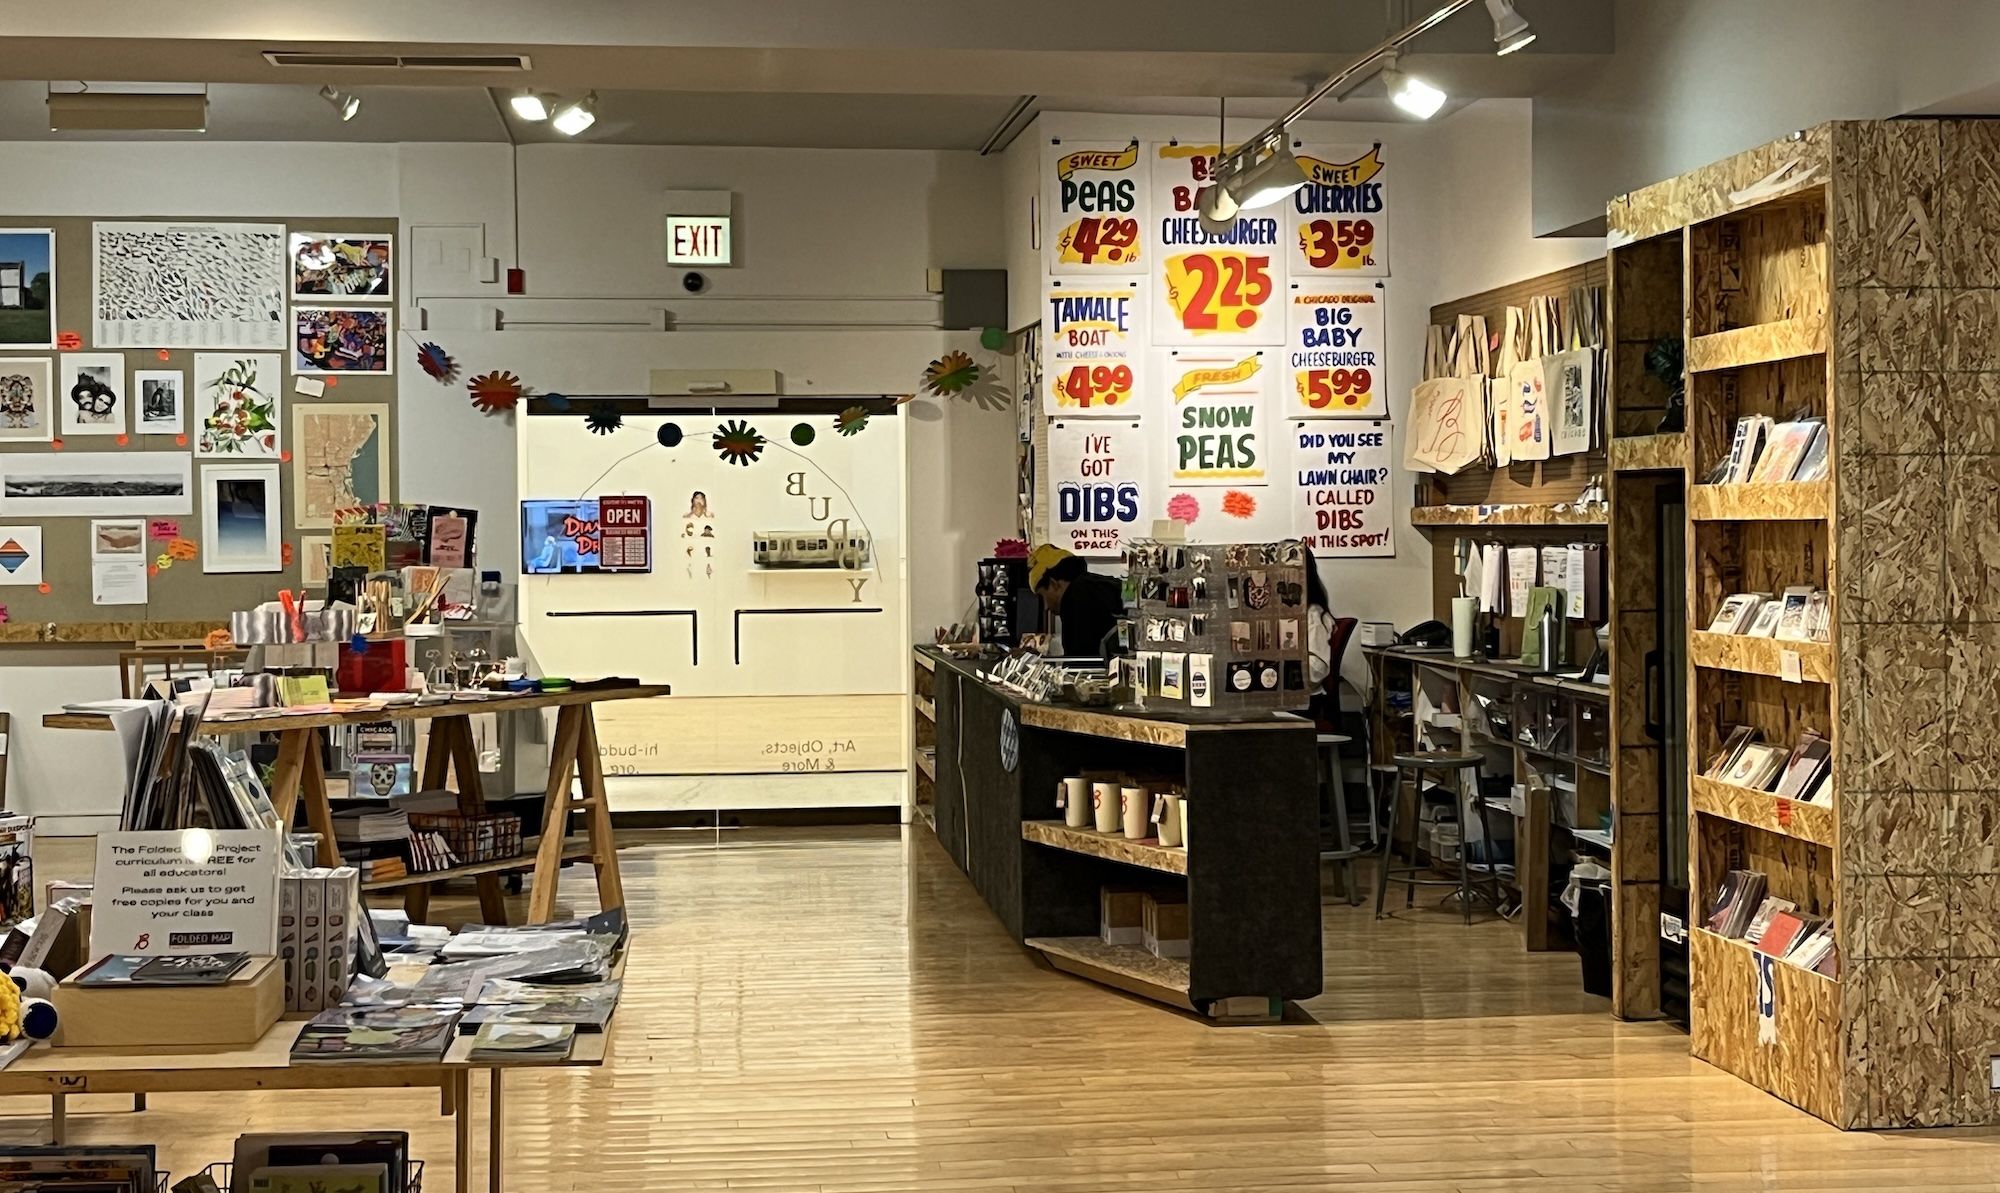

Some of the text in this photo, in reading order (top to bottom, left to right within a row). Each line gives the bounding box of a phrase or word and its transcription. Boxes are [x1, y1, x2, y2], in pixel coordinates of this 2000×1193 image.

[1069, 154, 1121, 168] SWEET
[1312, 164, 1360, 182] SWEET
[1295, 183, 1383, 214] CHERRIES
[675, 225, 722, 257] EXIT
[1050, 297, 1129, 333] TAMALE
[1315, 307, 1352, 326] BIG
[1068, 329, 1111, 347] BOAT
[1302, 327, 1363, 348] BABY
[1292, 352, 1376, 368] CHEESEBURGER
[1193, 371, 1241, 383] FRESH
[1182, 405, 1254, 429] SNOW
[1085, 433, 1111, 454] I'VE
[1300, 433, 1383, 448] DID YOU SEE
[1177, 433, 1256, 470] PEAS
[1328, 452, 1356, 465] MY
[1081, 458, 1115, 476] GOT
[1298, 468, 1388, 486] LAWN CHAIR?
[1057, 481, 1139, 523] DIBS
[1307, 490, 1374, 505] I CALLED
[606, 509, 640, 524] OPEN
[1316, 509, 1364, 530] DIBS
[1071, 528, 1119, 539] ON THIS
[1320, 535, 1349, 548] THIS
[1351, 528, 1389, 547] SPOT!
[1074, 539, 1118, 549] SPACE!
[112, 846, 135, 854] The
[216, 844, 261, 854] Project
[115, 857, 182, 866] curriculum
[237, 856, 256, 864] for
[143, 868, 226, 877] all educators!
[122, 886, 163, 894] Please
[166, 886, 187, 894] ask
[224, 885, 246, 895] get
[112, 896, 255, 907] free copies for you and
[151, 909, 214, 919] your class
[171, 934, 209, 944] FOLDED
[211, 933, 231, 943] MAP
